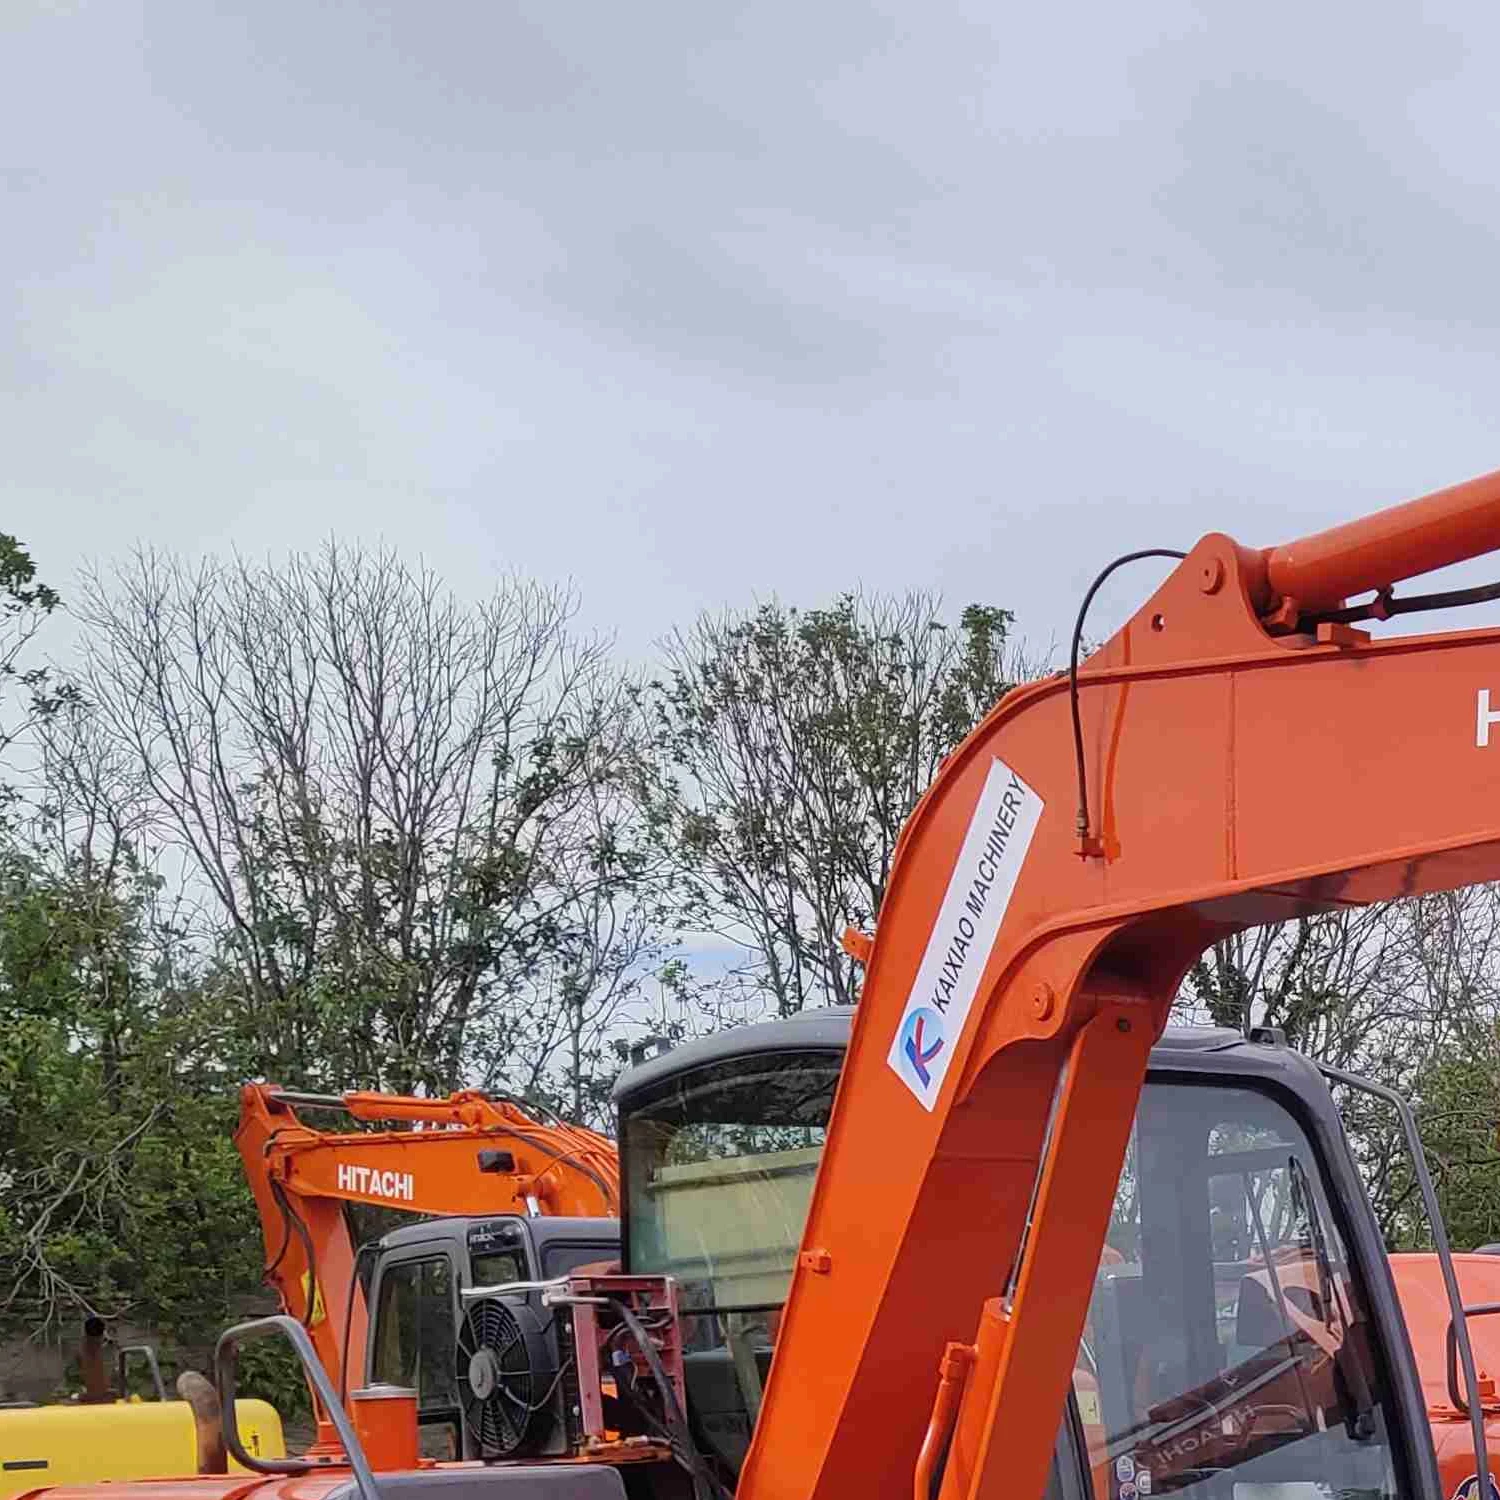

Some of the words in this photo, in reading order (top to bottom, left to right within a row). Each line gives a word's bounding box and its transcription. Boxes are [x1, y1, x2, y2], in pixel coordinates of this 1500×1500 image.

[931, 917, 975, 1014] KAIXIAO
[966, 774, 1026, 919] MACHINERY
[338, 1164, 414, 1200] HITACHI
